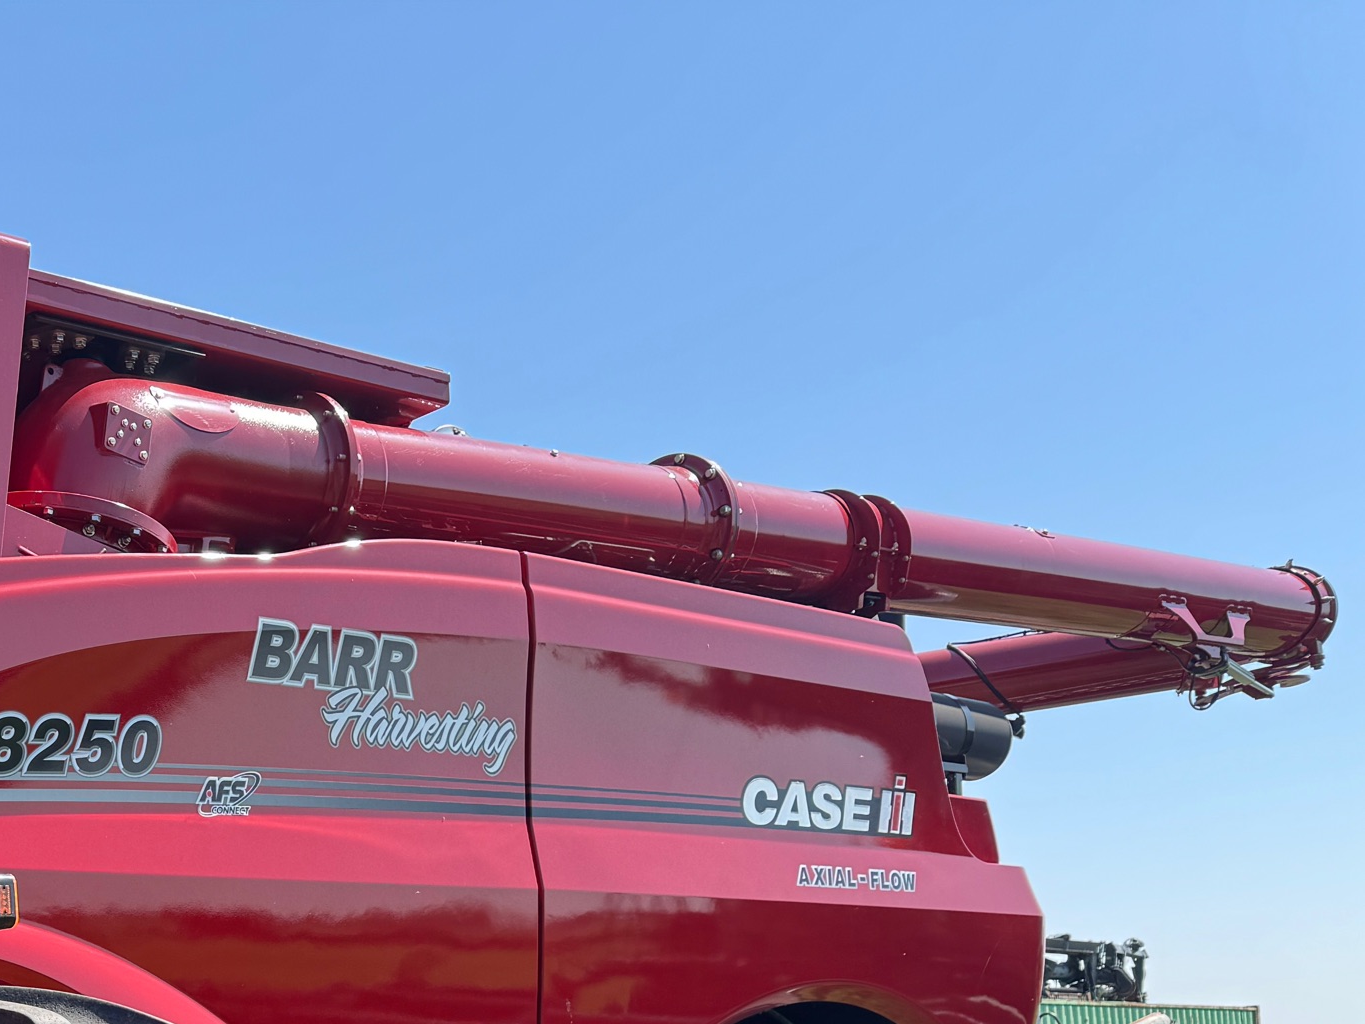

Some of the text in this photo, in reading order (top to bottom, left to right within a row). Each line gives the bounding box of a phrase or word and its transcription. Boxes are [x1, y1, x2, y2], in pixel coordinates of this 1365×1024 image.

[246, 616, 418, 700] BARR
[321, 685, 516, 776] Harvesting
[196, 776, 249, 804] AFS
[211, 805, 251, 816] CONNECT
[742, 776, 875, 834] CASE
[796, 864, 917, 893] AXIAL-FLOW
